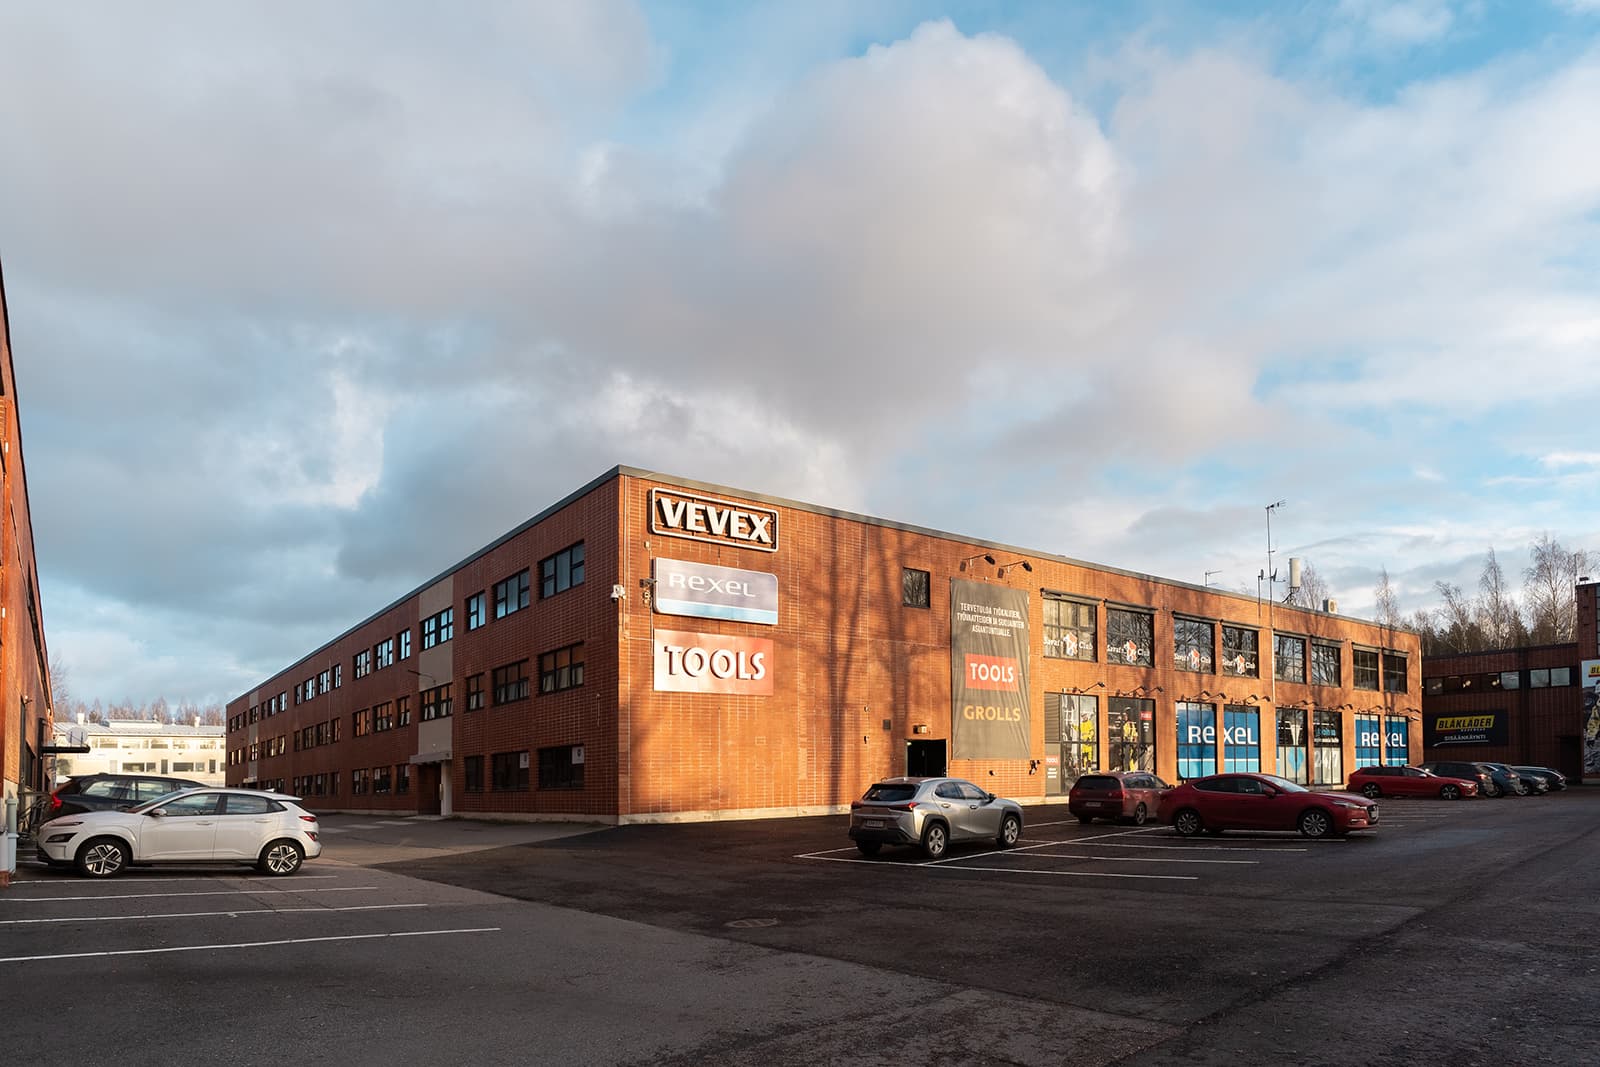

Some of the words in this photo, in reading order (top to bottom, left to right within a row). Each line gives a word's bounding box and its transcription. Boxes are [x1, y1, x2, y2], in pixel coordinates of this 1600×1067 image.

[660, 497, 772, 544] VEVEX
[960, 602, 992, 615] TERVETULOA
[666, 646, 766, 680] TOOLS
[970, 663, 1014, 683] TOOLS
[963, 704, 1021, 722] GROLLS
